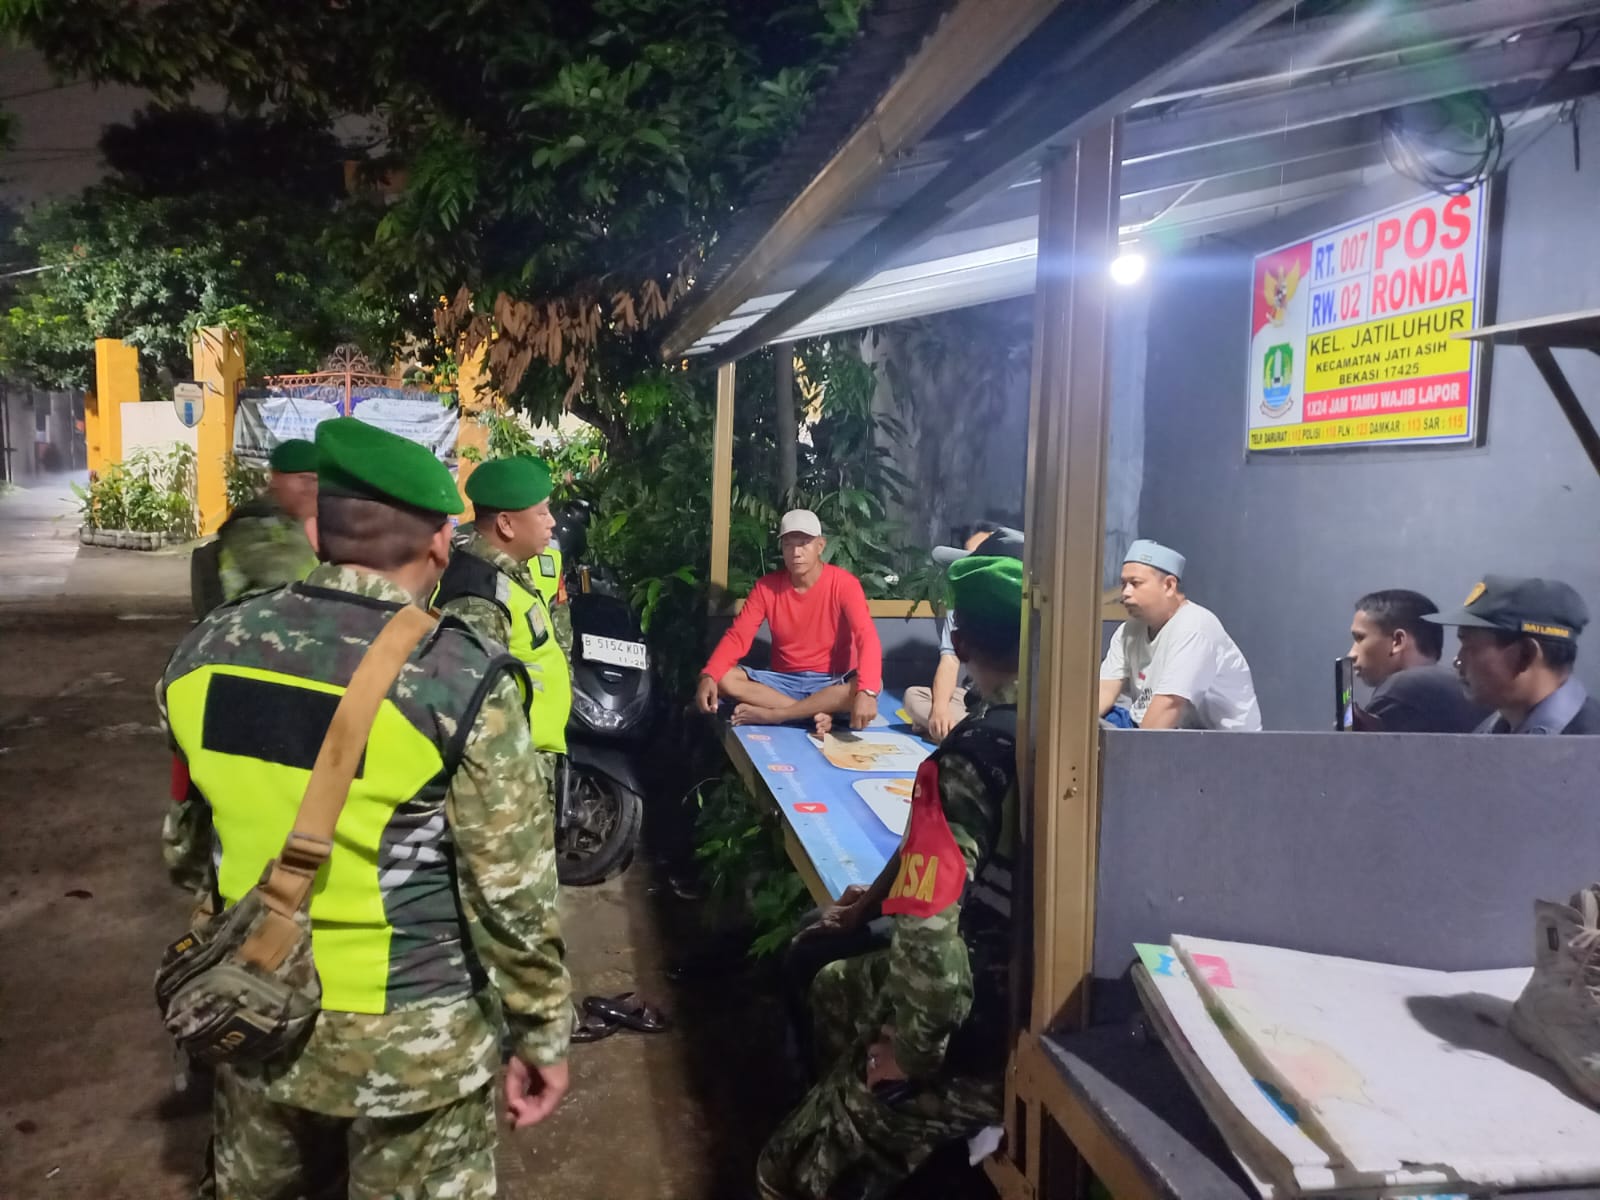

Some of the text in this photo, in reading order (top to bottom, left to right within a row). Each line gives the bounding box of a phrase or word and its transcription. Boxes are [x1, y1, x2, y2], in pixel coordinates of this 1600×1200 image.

[1374, 194, 1471, 270] POS
[1314, 231, 1368, 281] RT. 007
[1311, 282, 1361, 328] RW. 02
[1371, 252, 1468, 315] RONDA
[1310, 308, 1465, 357] KEL. JATILUHUR
[1315, 340, 1447, 374] KECAMATAN JATI ASIH
[1338, 362, 1420, 385] BEKASI 17425
[1328, 396, 1348, 414] JAM
[1350, 393, 1378, 412] TAMU
[1380, 387, 1416, 408] WAJIB
[1418, 382, 1460, 404] LAPOR
[1369, 419, 1400, 435] DAMKAR
[1423, 416, 1440, 430] SAR
